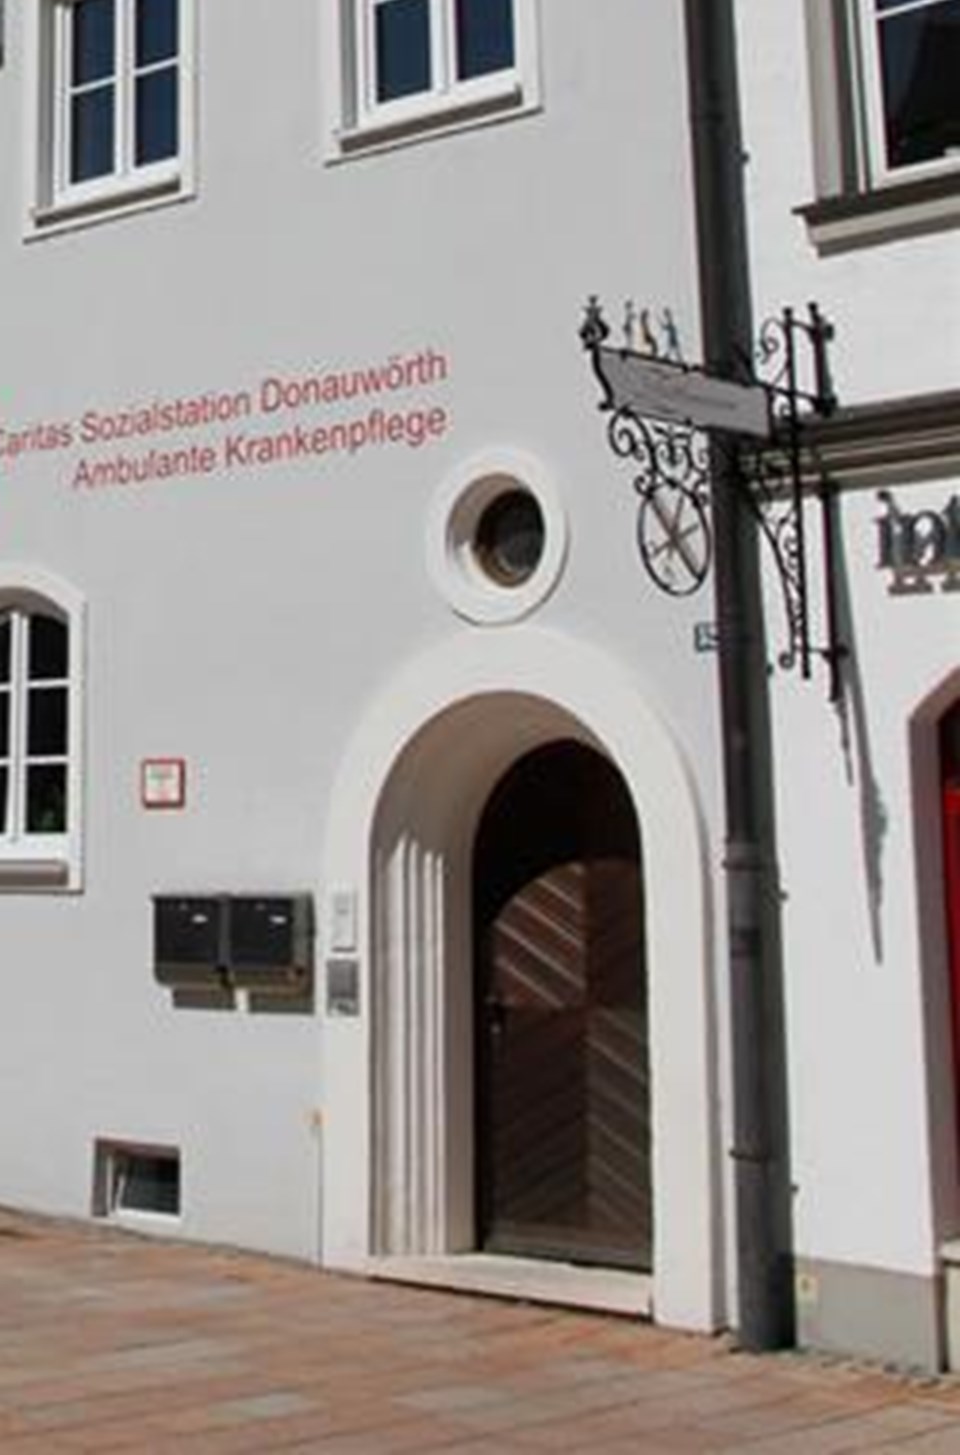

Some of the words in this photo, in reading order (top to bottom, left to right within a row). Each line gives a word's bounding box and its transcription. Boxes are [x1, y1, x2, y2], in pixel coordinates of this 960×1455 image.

[80, 392, 252, 443] Sozialstation
[259, 347, 448, 413] Donauwörth
[71, 443, 217, 488] Ambulante
[224, 405, 447, 468] Krankenpflege
